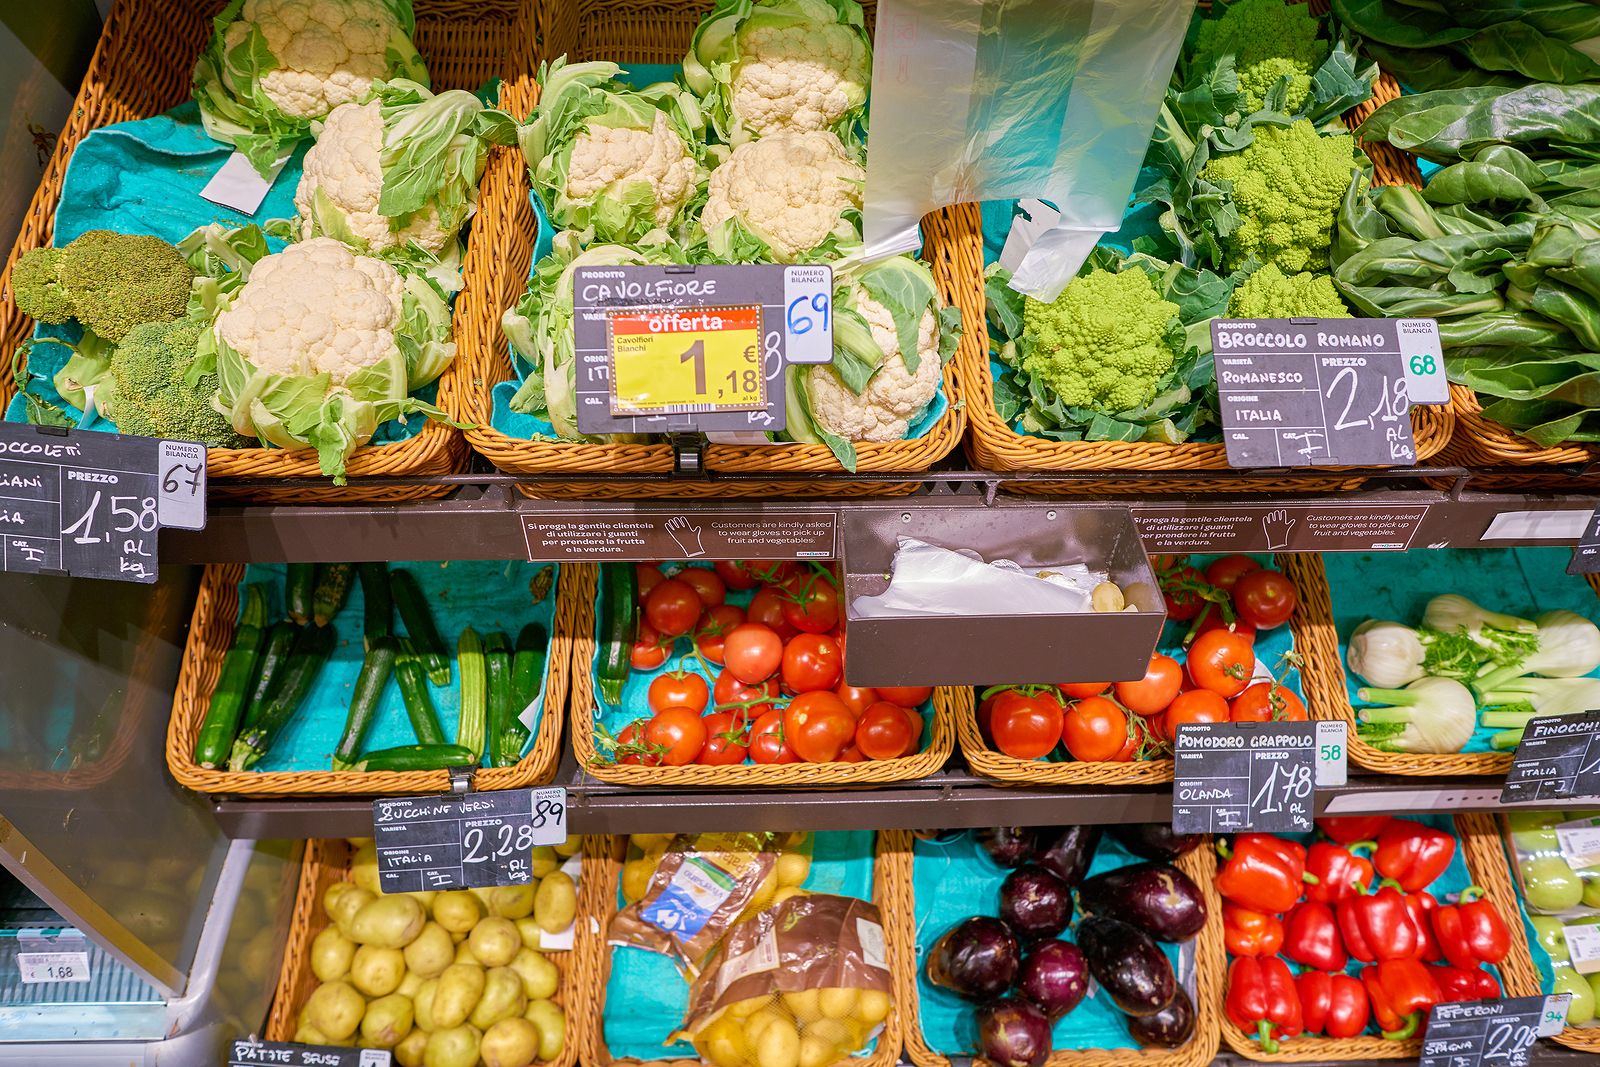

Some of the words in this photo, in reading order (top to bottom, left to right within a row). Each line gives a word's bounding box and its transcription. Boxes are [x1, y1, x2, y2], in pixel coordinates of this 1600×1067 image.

[582, 271, 625, 279] PRODOTTO
[787, 292, 829, 335] 69
[648, 313, 723, 333] offerta
[617, 336, 653, 344] Cavolfiori
[1218, 332, 1307, 349] BROCCOLO
[1317, 332, 1385, 347] ROMANO
[617, 344, 646, 352] Bianchi
[1322, 357, 1367, 367] PREZZO
[1409, 354, 1437, 376] 68
[1222, 372, 1303, 384] ROMANESCO
[1326, 367, 1410, 431] 2,18
[1235, 409, 1282, 422] ITALIA
[1386, 424, 1408, 442] AL
[165, 444, 199, 453] NUMERO
[165, 451, 199, 459] BILANCIA
[67, 470, 119, 484] PREZZO
[162, 463, 203, 497] 67
[61, 490, 158, 545] 1,58
[1143, 517, 1169, 525] prega
[1180, 516, 1211, 524] gentile
[1369, 514, 1394, 522] kindly
[539, 523, 566, 532] prega
[579, 523, 611, 532] gentile
[612, 522, 654, 530] clientela
[778, 521, 804, 530] kindly
[1205, 524, 1235, 532] guanti
[1340, 522, 1368, 530] gloves
[1378, 522, 1397, 530] pick
[608, 531, 639, 539] guanti
[752, 529, 781, 537] gloves
[793, 529, 812, 538] pick
[813, 530, 825, 538] up
[560, 539, 605, 547] prendere
[766, 537, 816, 545] vegetables.
[123, 540, 152, 556] AL
[1178, 735, 1245, 749] POMODORO
[1250, 734, 1313, 748] GRAPPOLO
[1255, 752, 1290, 760] PREZZO
[1320, 744, 1341, 761] 58
[1521, 767, 1557, 777] ITALIA
[1251, 761, 1313, 815] 1,78
[1179, 788, 1233, 801] OLANDA
[531, 799, 564, 829] 89
[1289, 803, 1306, 814] AL
[464, 818, 503, 828] PREZZO
[462, 824, 534, 864] 2,28
[509, 859, 529, 871] AL
[47, 966, 73, 978] 1.68
[1545, 1011, 1564, 1024] 94
[235, 1047, 294, 1062] PATATE
[1425, 1041, 1473, 1056] SPAGNA
